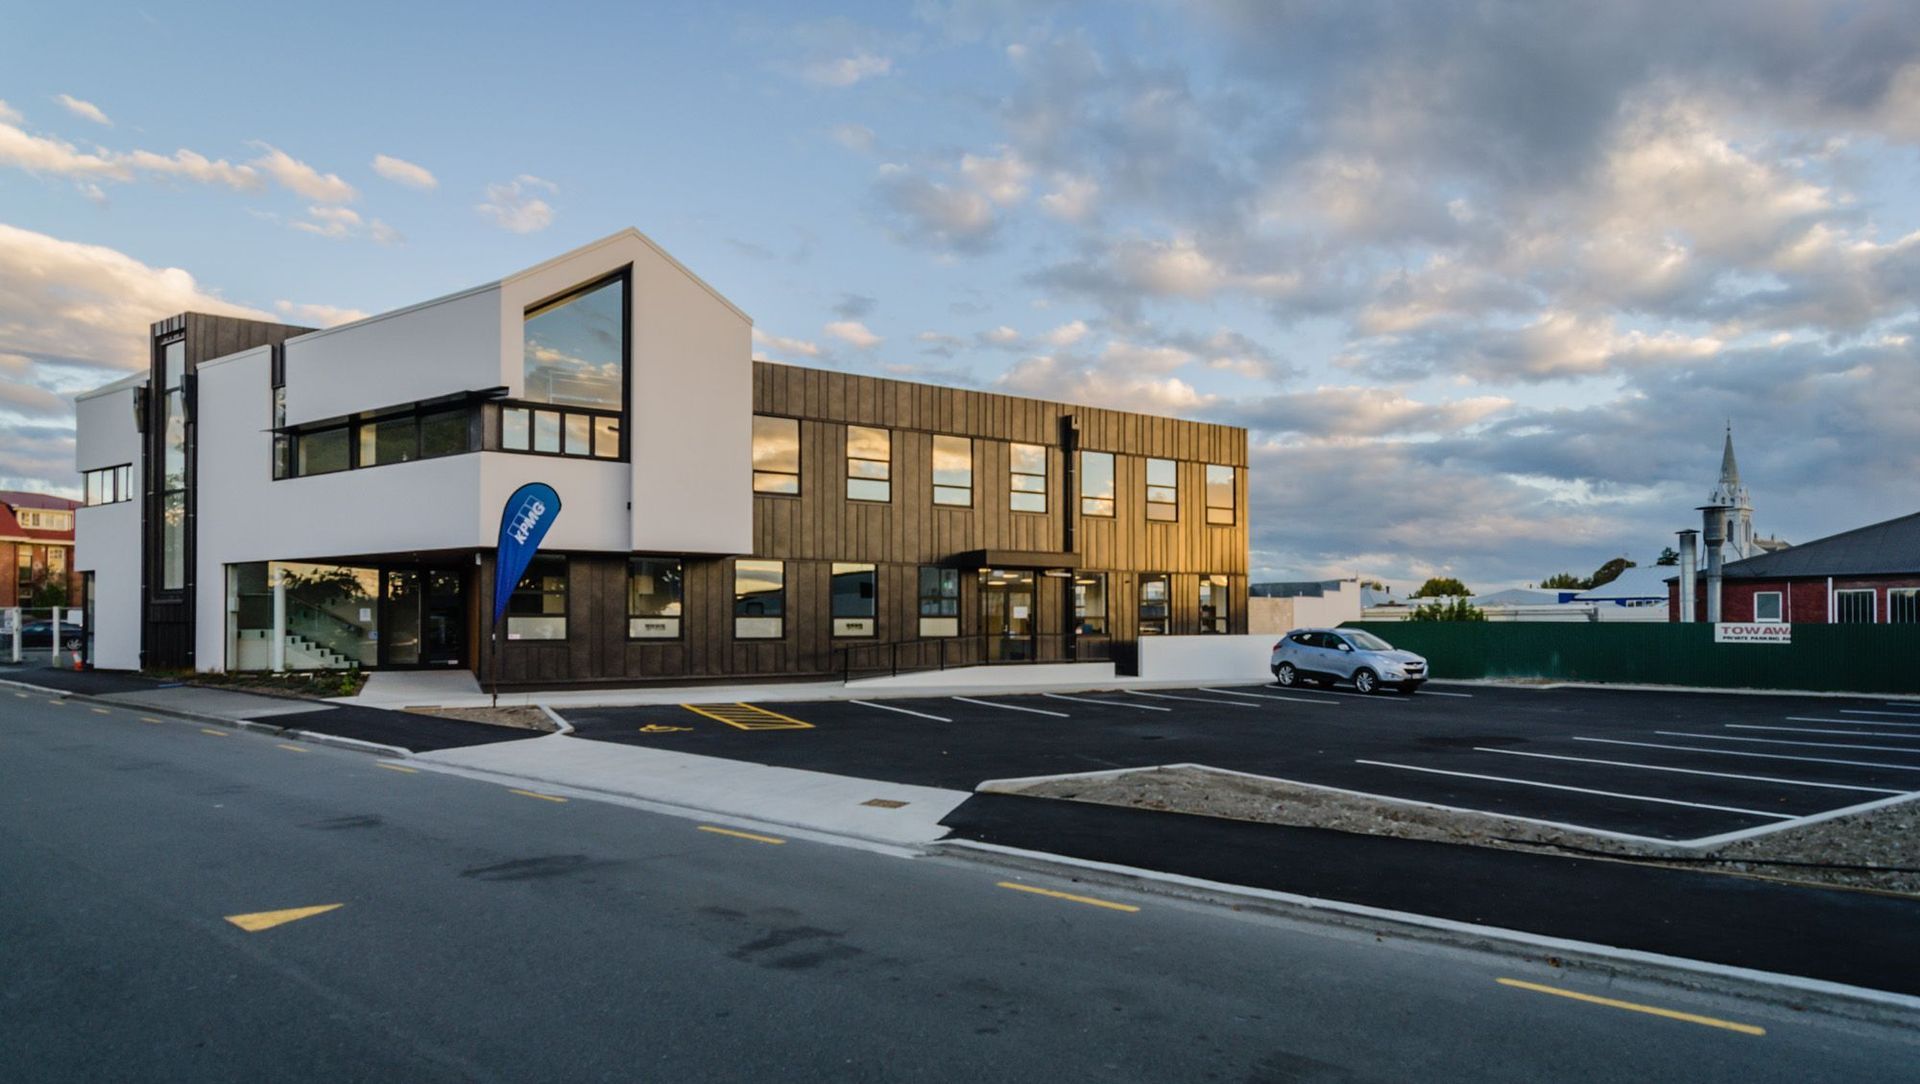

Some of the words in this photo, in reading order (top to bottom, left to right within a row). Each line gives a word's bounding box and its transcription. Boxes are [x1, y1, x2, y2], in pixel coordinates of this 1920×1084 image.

[514, 501, 546, 545] KPMG
[1721, 626, 1760, 635] TOW
[1763, 626, 1791, 635] AW
